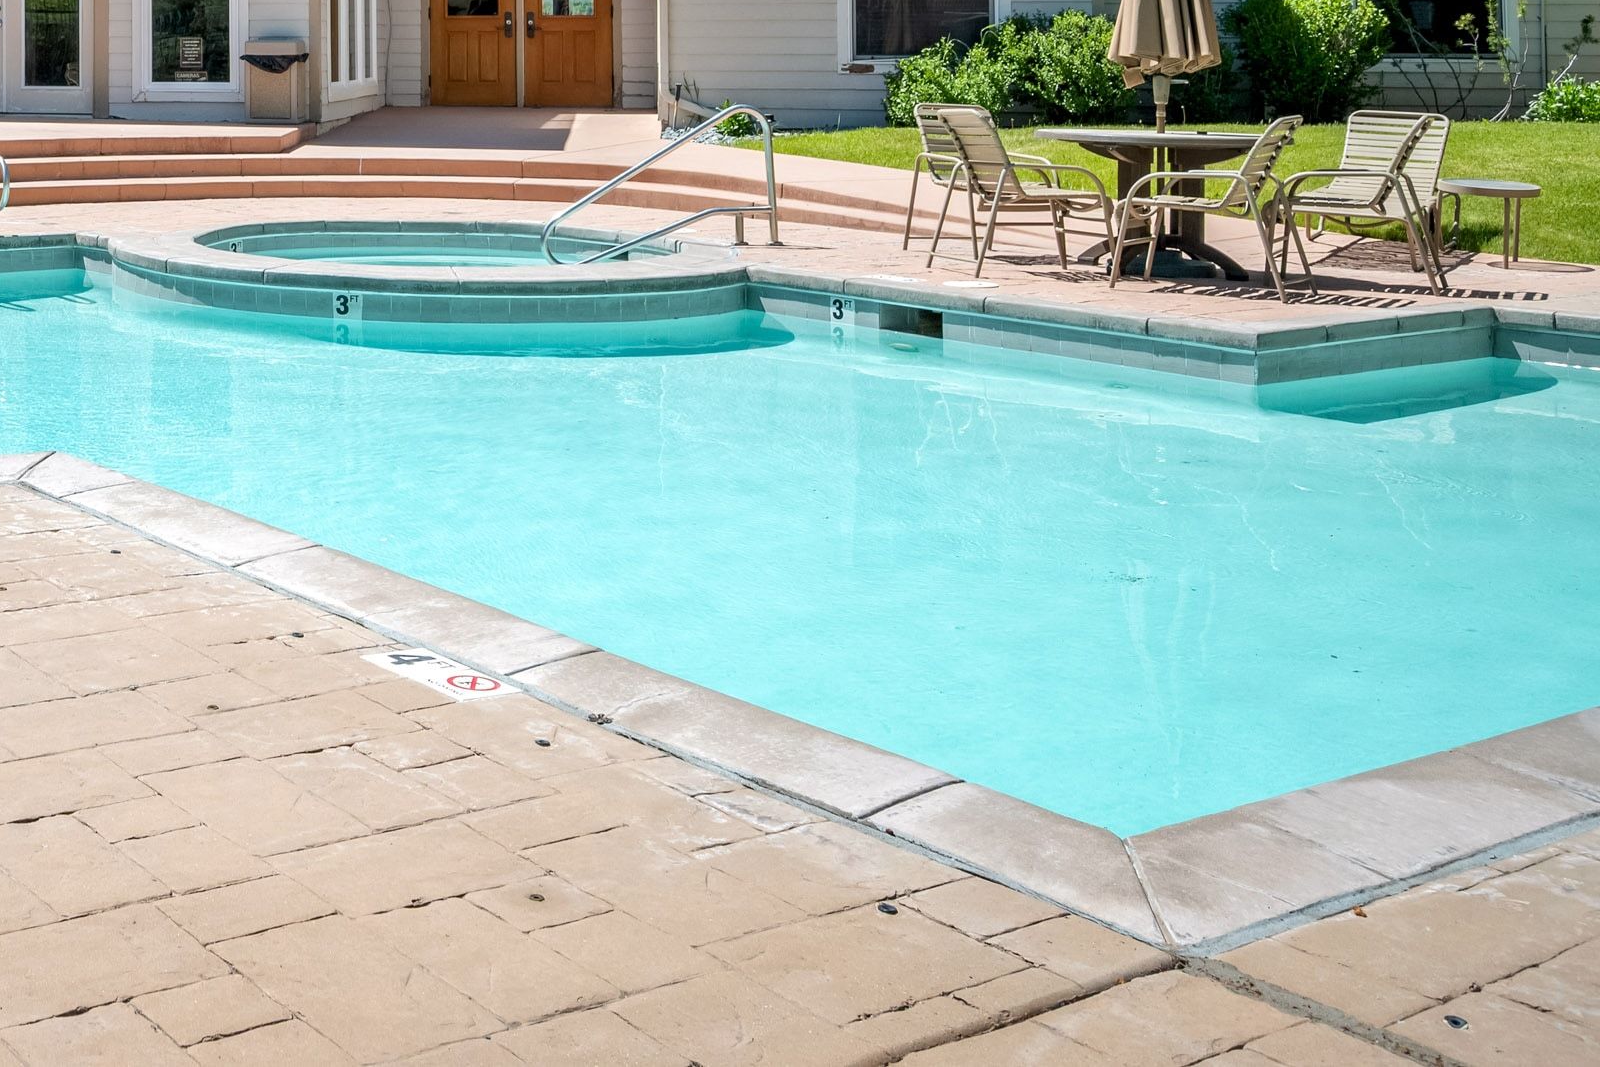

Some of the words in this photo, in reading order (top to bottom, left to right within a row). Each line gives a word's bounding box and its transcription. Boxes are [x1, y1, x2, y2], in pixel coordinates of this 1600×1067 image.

[336, 295, 349, 315] 3
[832, 299, 844, 319] 3
[844, 300, 852, 308] FT
[387, 654, 436, 665] 4
